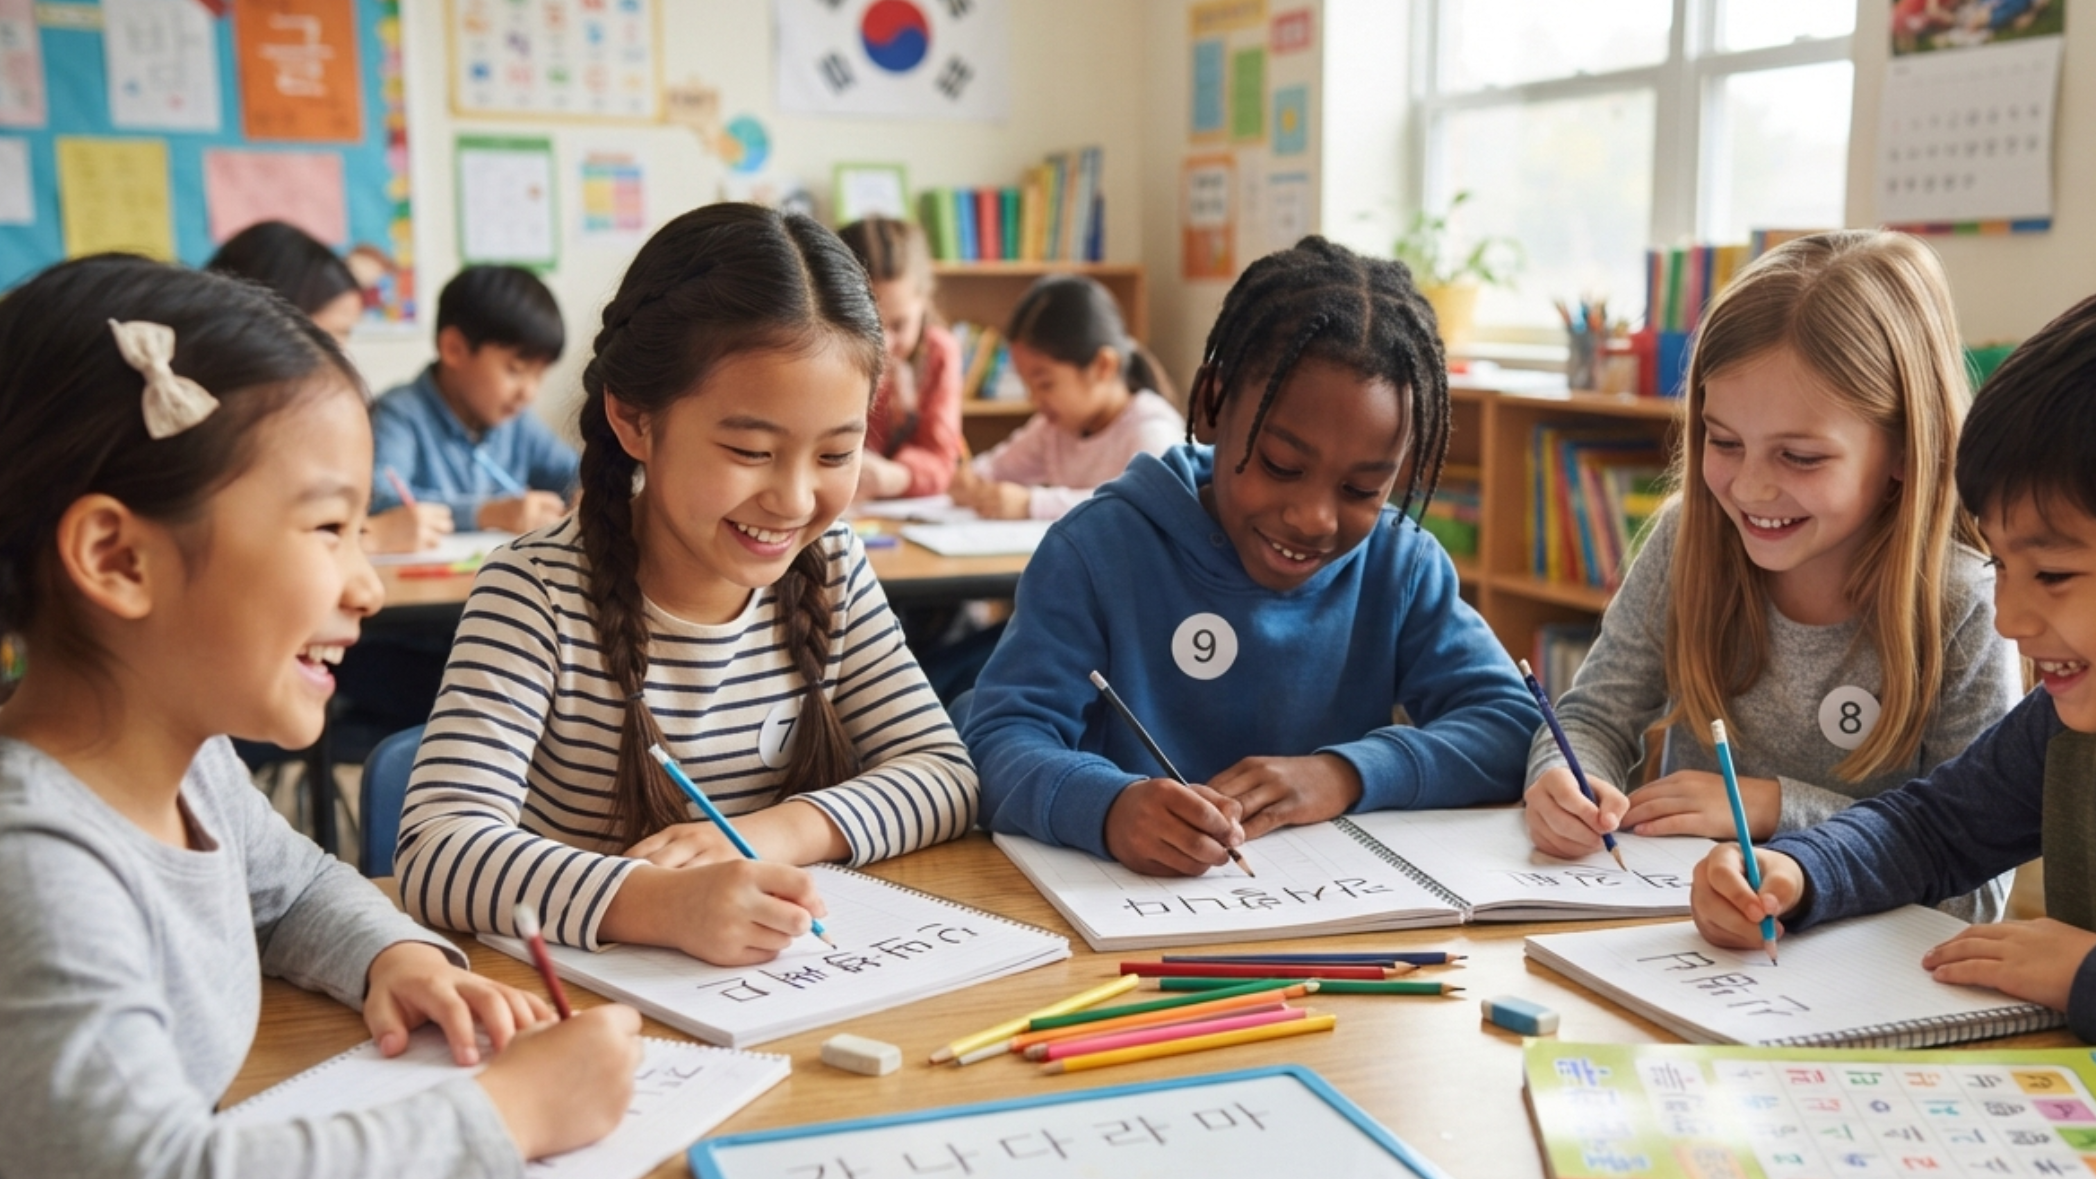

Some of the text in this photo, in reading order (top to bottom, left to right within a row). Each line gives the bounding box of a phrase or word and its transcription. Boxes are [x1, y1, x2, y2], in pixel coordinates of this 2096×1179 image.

[1192, 629, 1217, 663] 9
[1839, 700, 1862, 734] 8
[777, 717, 798, 753] 7
[903, 1143, 979, 1175] 나
[999, 1128, 1075, 1161] 다
[1092, 1114, 1171, 1147] 라
[1192, 1101, 1271, 1132] 마
